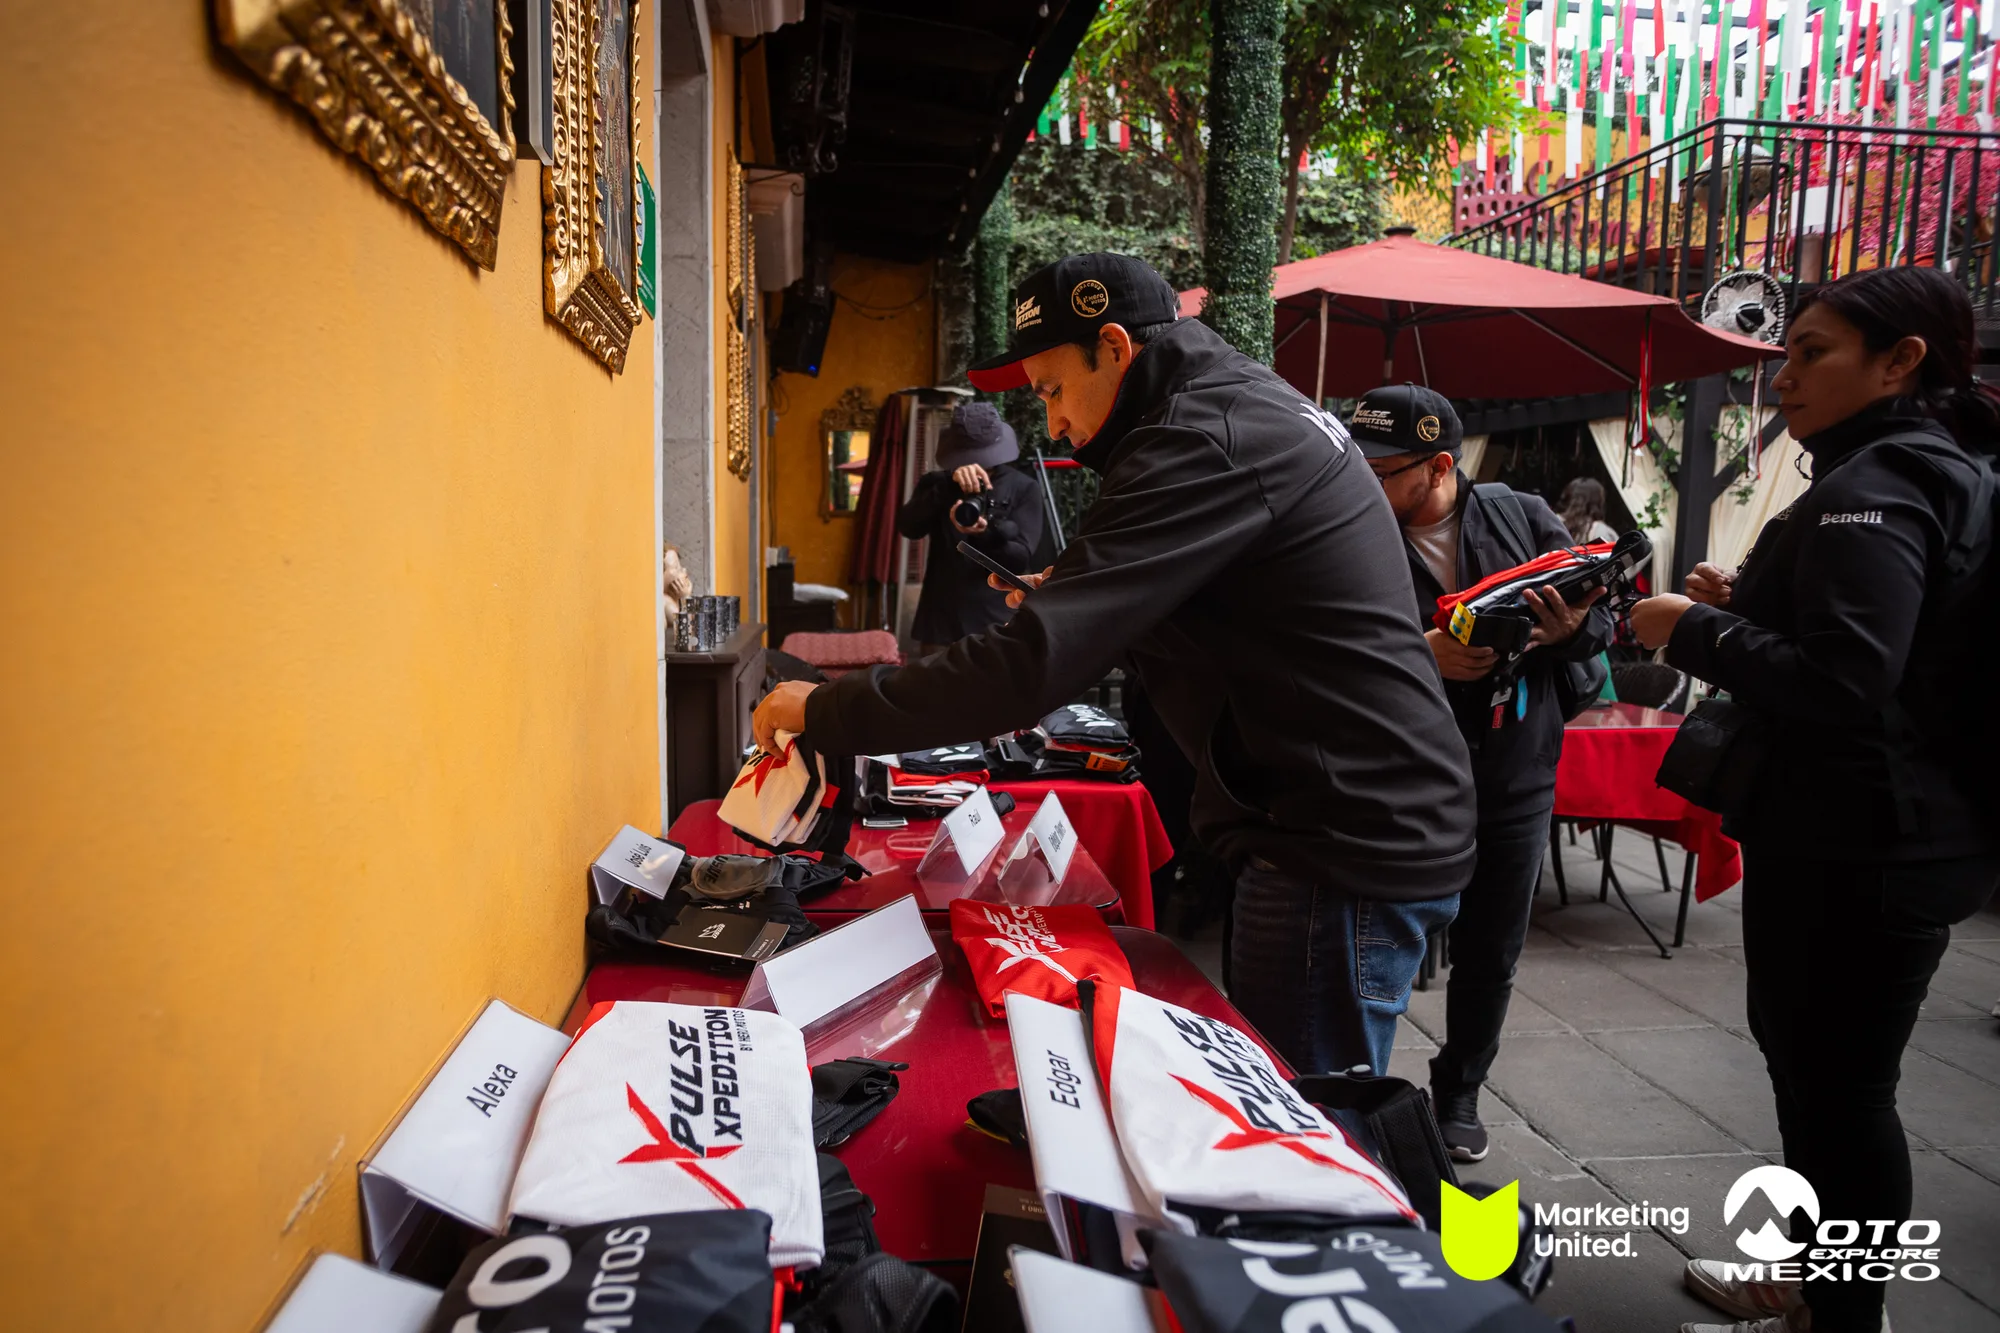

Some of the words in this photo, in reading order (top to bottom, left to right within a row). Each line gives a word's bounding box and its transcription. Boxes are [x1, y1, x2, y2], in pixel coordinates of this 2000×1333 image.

[1819, 511, 1883, 525] Benelli
[466, 1063, 518, 1118] Alexa
[704, 1009, 742, 1140] XPEDITION
[1046, 1049, 1081, 1109] Edgar
